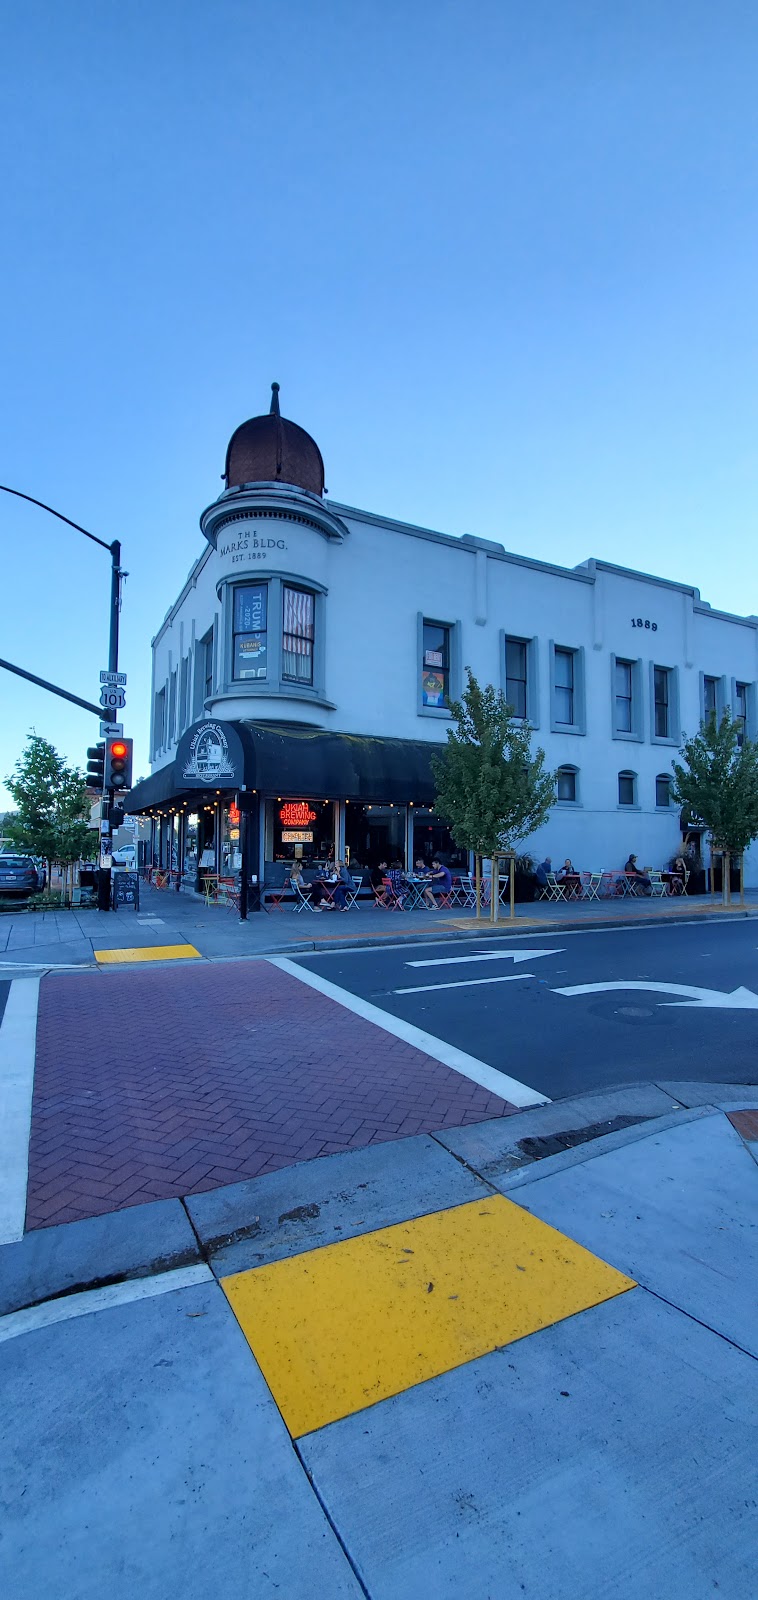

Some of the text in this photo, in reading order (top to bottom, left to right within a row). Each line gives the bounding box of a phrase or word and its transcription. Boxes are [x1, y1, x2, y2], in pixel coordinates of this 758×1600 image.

[238, 530, 257, 539] THE
[220, 538, 288, 557] MARKS BLDG.
[232, 552, 267, 563] EST. 1889
[631, 618, 658, 631] 1889
[104, 693, 122, 706] 101
[190, 722, 228, 749] Ukiah Brewing Company
[284, 803, 309, 812] UKIAH
[280, 811, 317, 820] BREWING
